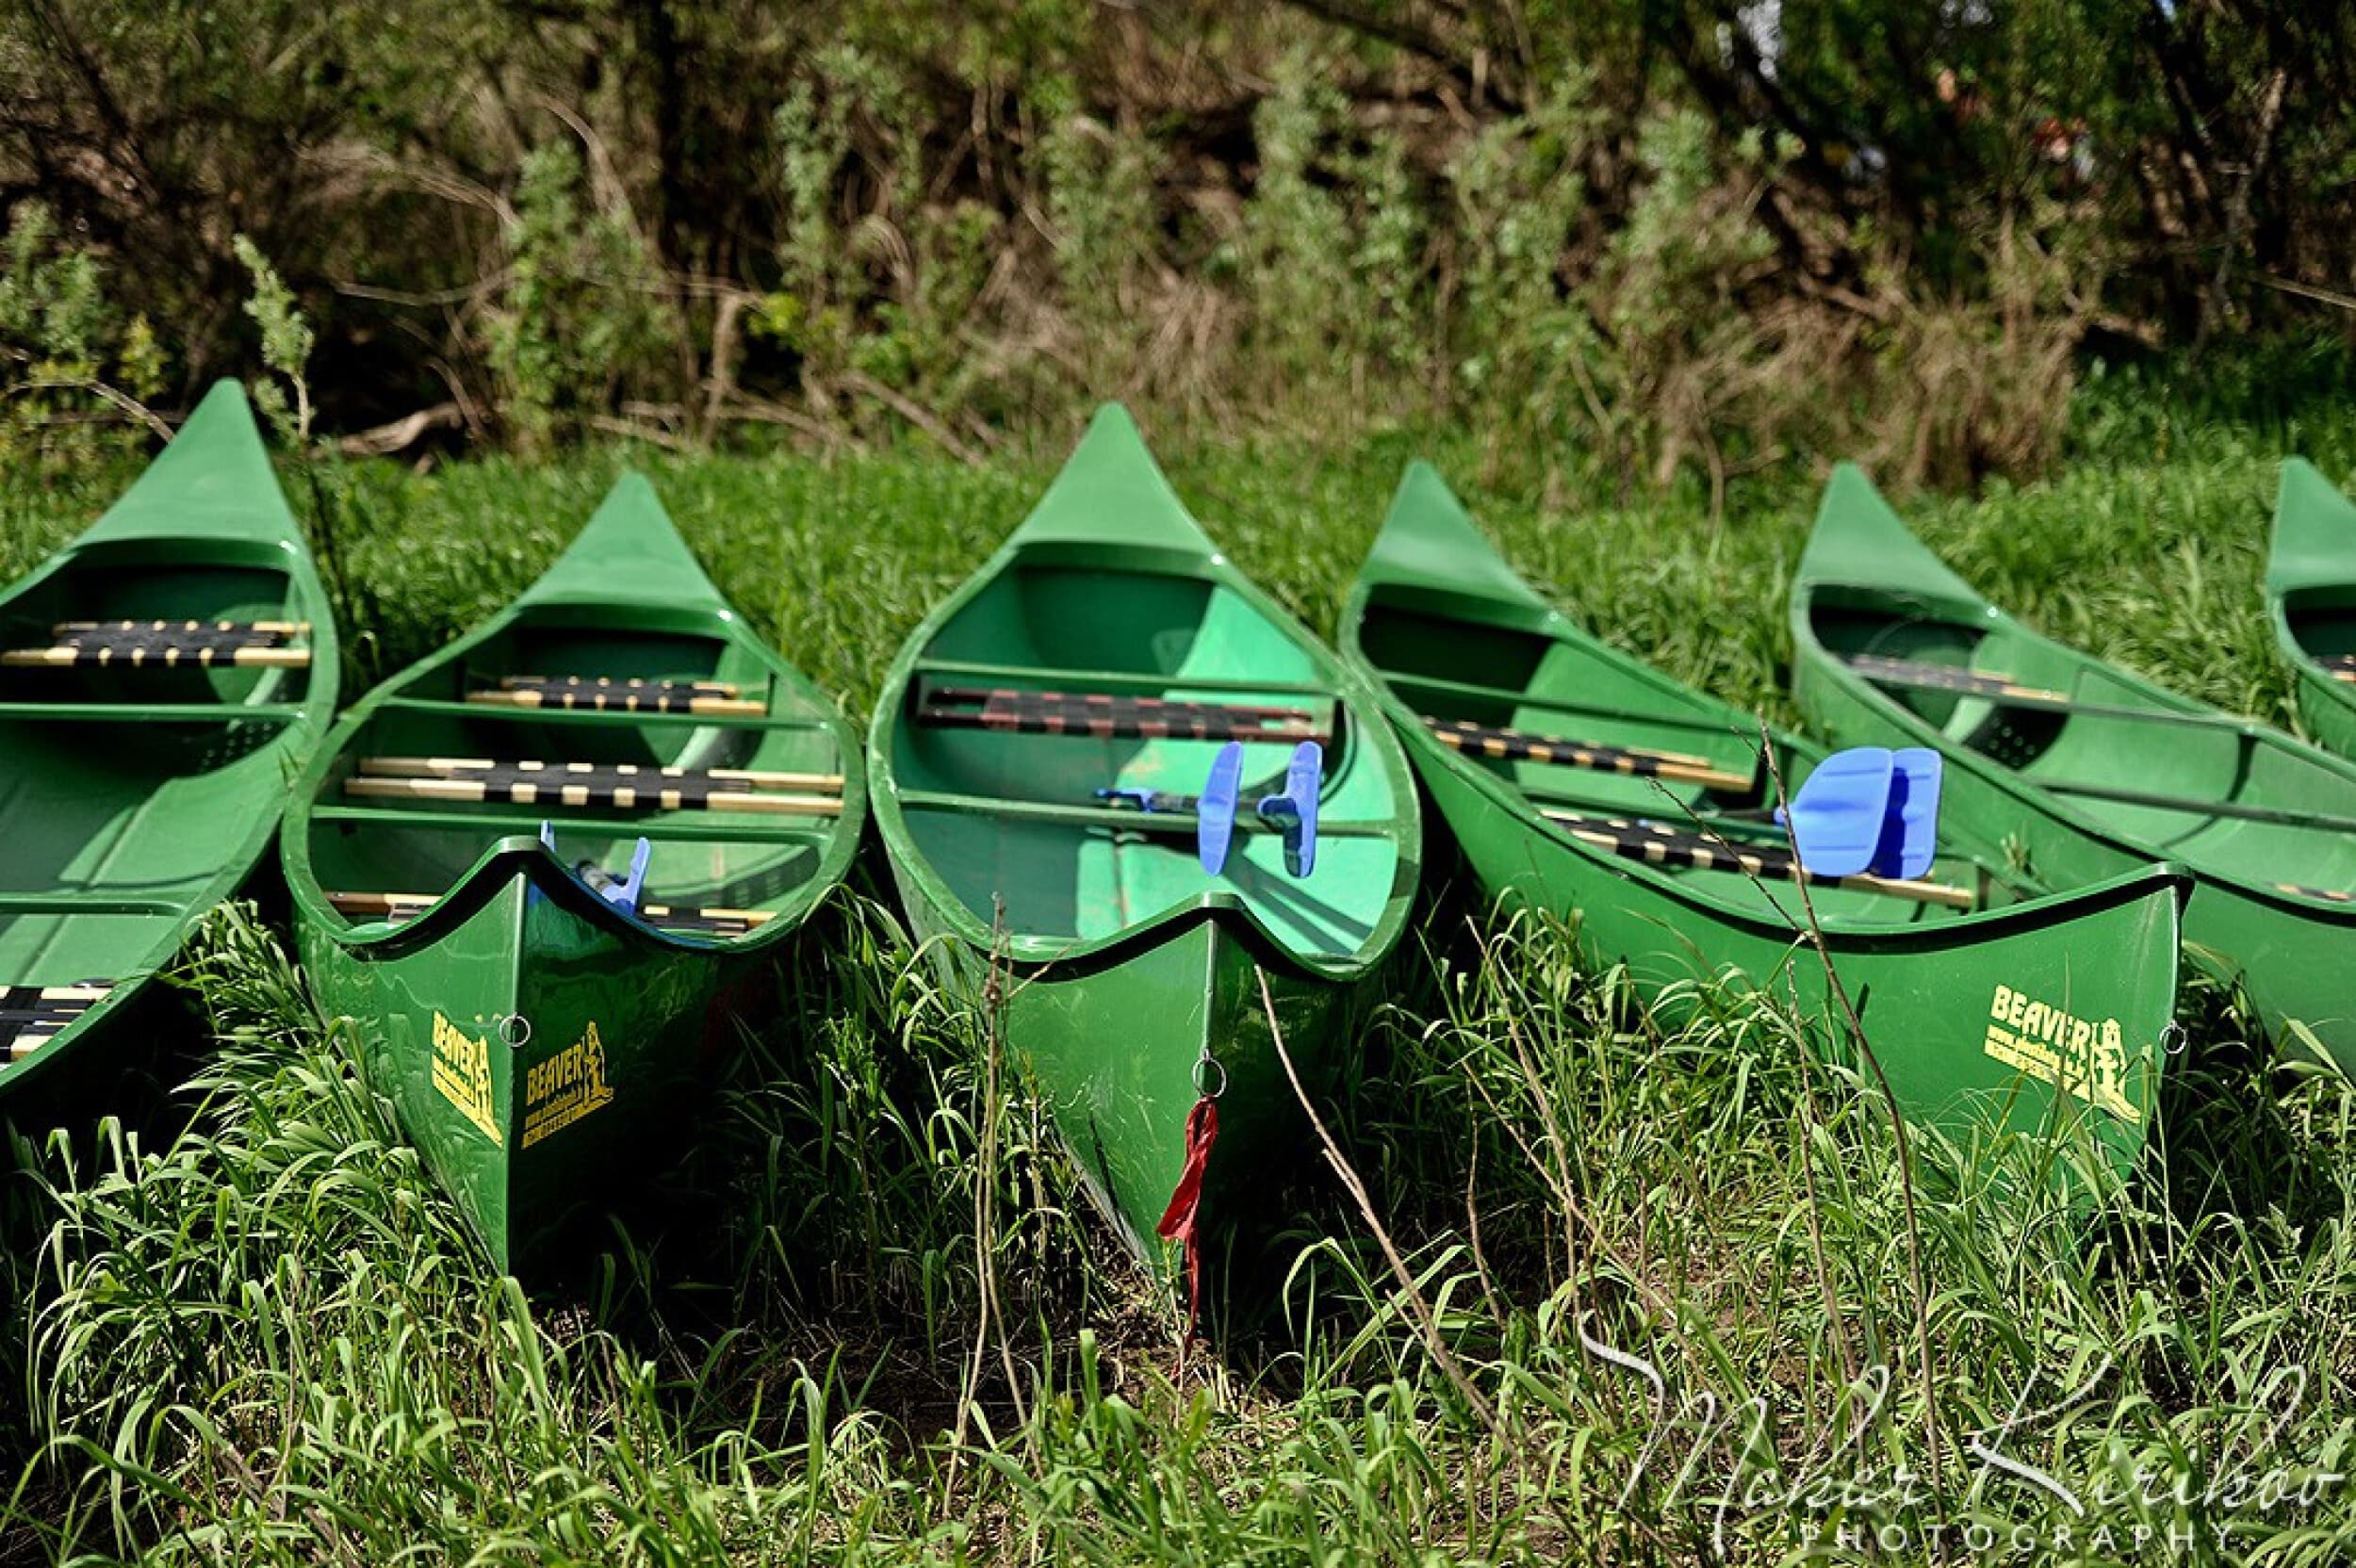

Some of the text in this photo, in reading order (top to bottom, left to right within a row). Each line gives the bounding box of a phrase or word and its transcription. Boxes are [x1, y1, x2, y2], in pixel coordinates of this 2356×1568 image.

[433, 1009, 479, 1079] BEAVER
[1990, 984, 2091, 1060] BEAVER
[527, 1041, 583, 1106] BEAVER
